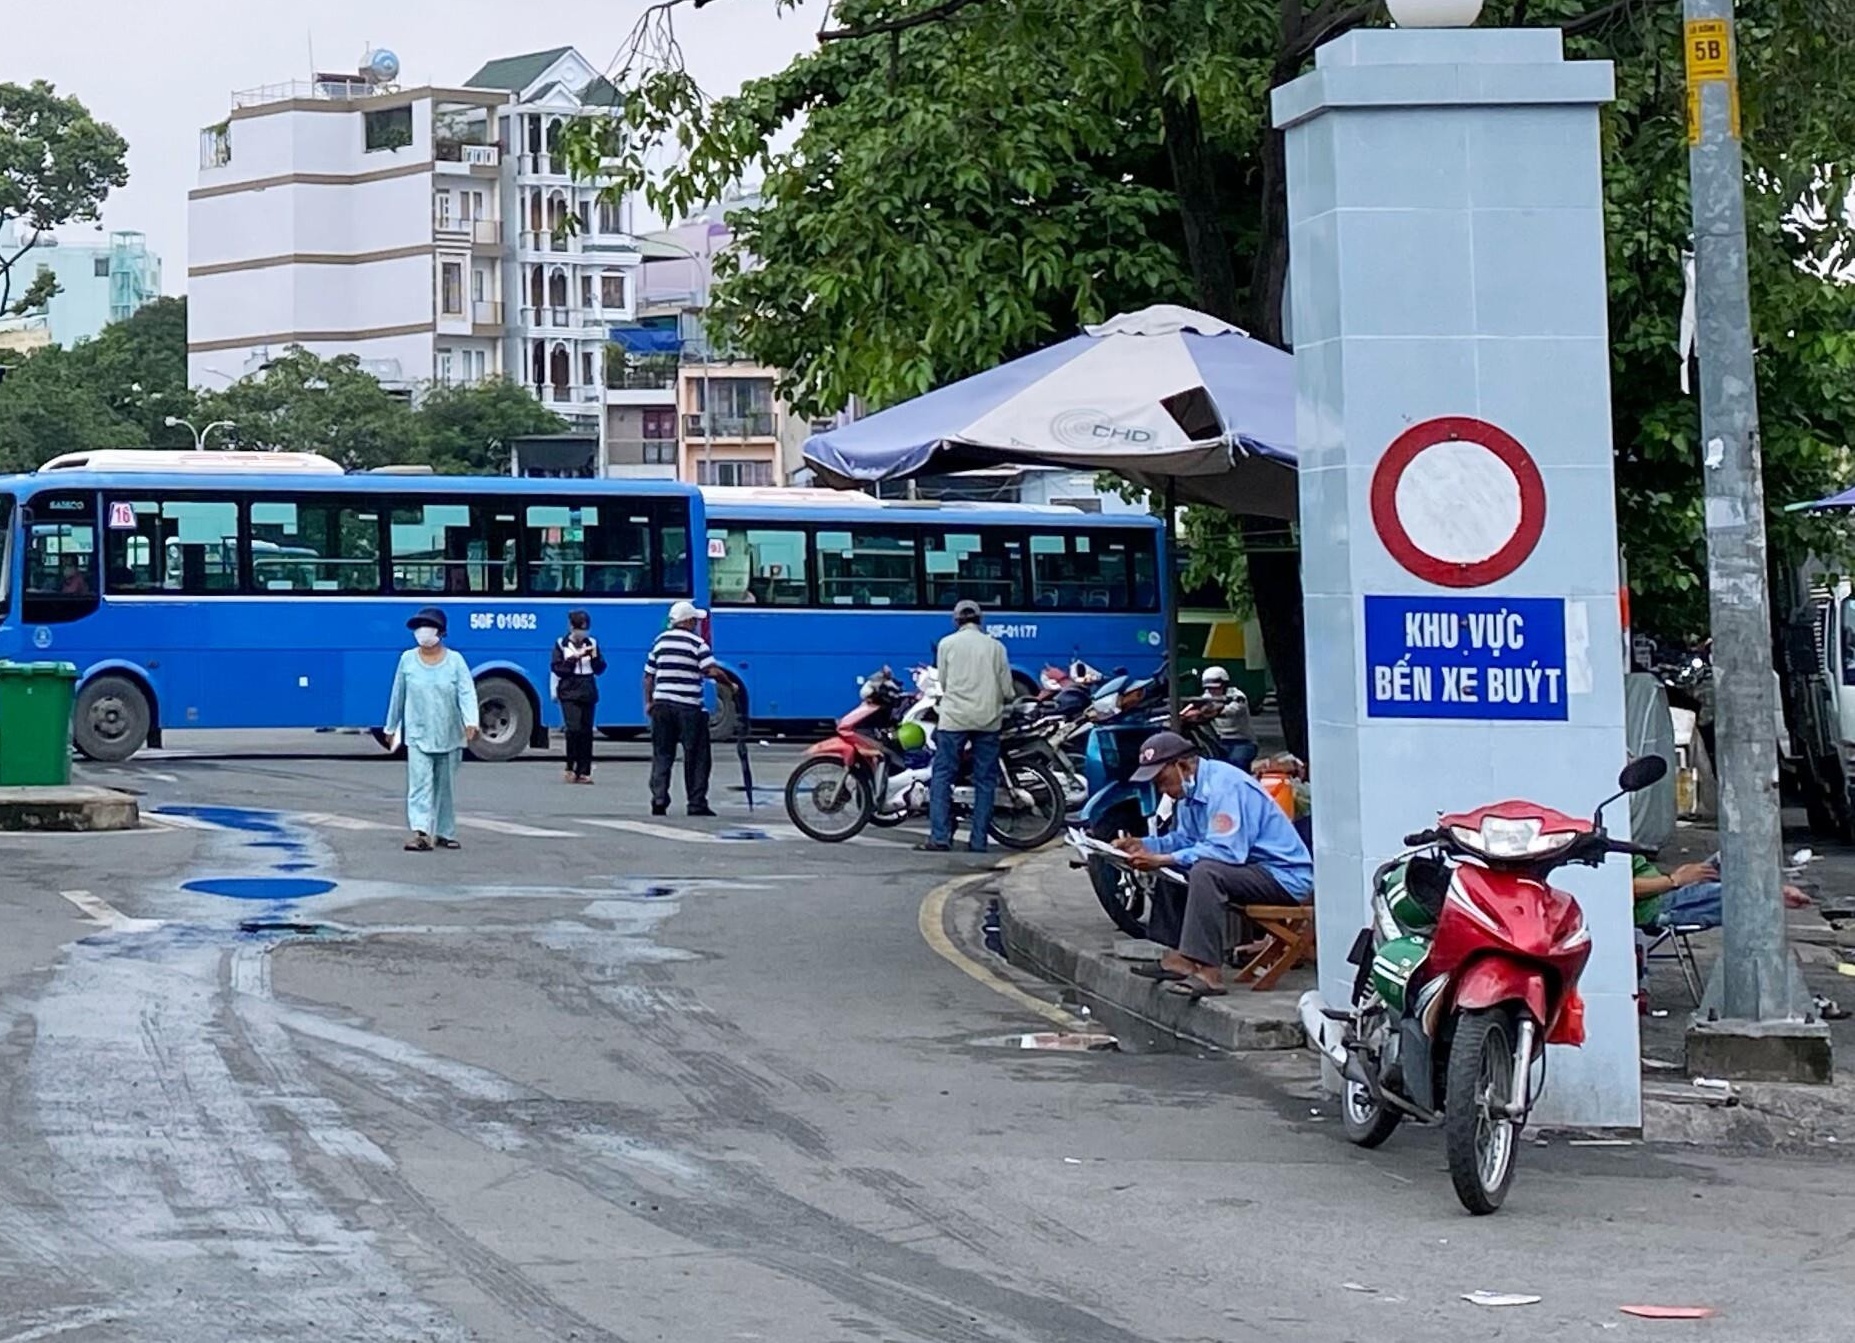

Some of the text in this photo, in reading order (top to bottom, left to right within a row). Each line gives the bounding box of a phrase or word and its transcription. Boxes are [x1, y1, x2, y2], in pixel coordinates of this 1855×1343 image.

[1695, 40, 1721, 61] 5B
[1092, 424, 1151, 443] CHD
[115, 506, 132, 524] 16
[470, 613, 537, 630] 50F 01052
[1405, 608, 1524, 657] KHU VỰC
[1374, 653, 1561, 704] BẾN XE BUÝT
